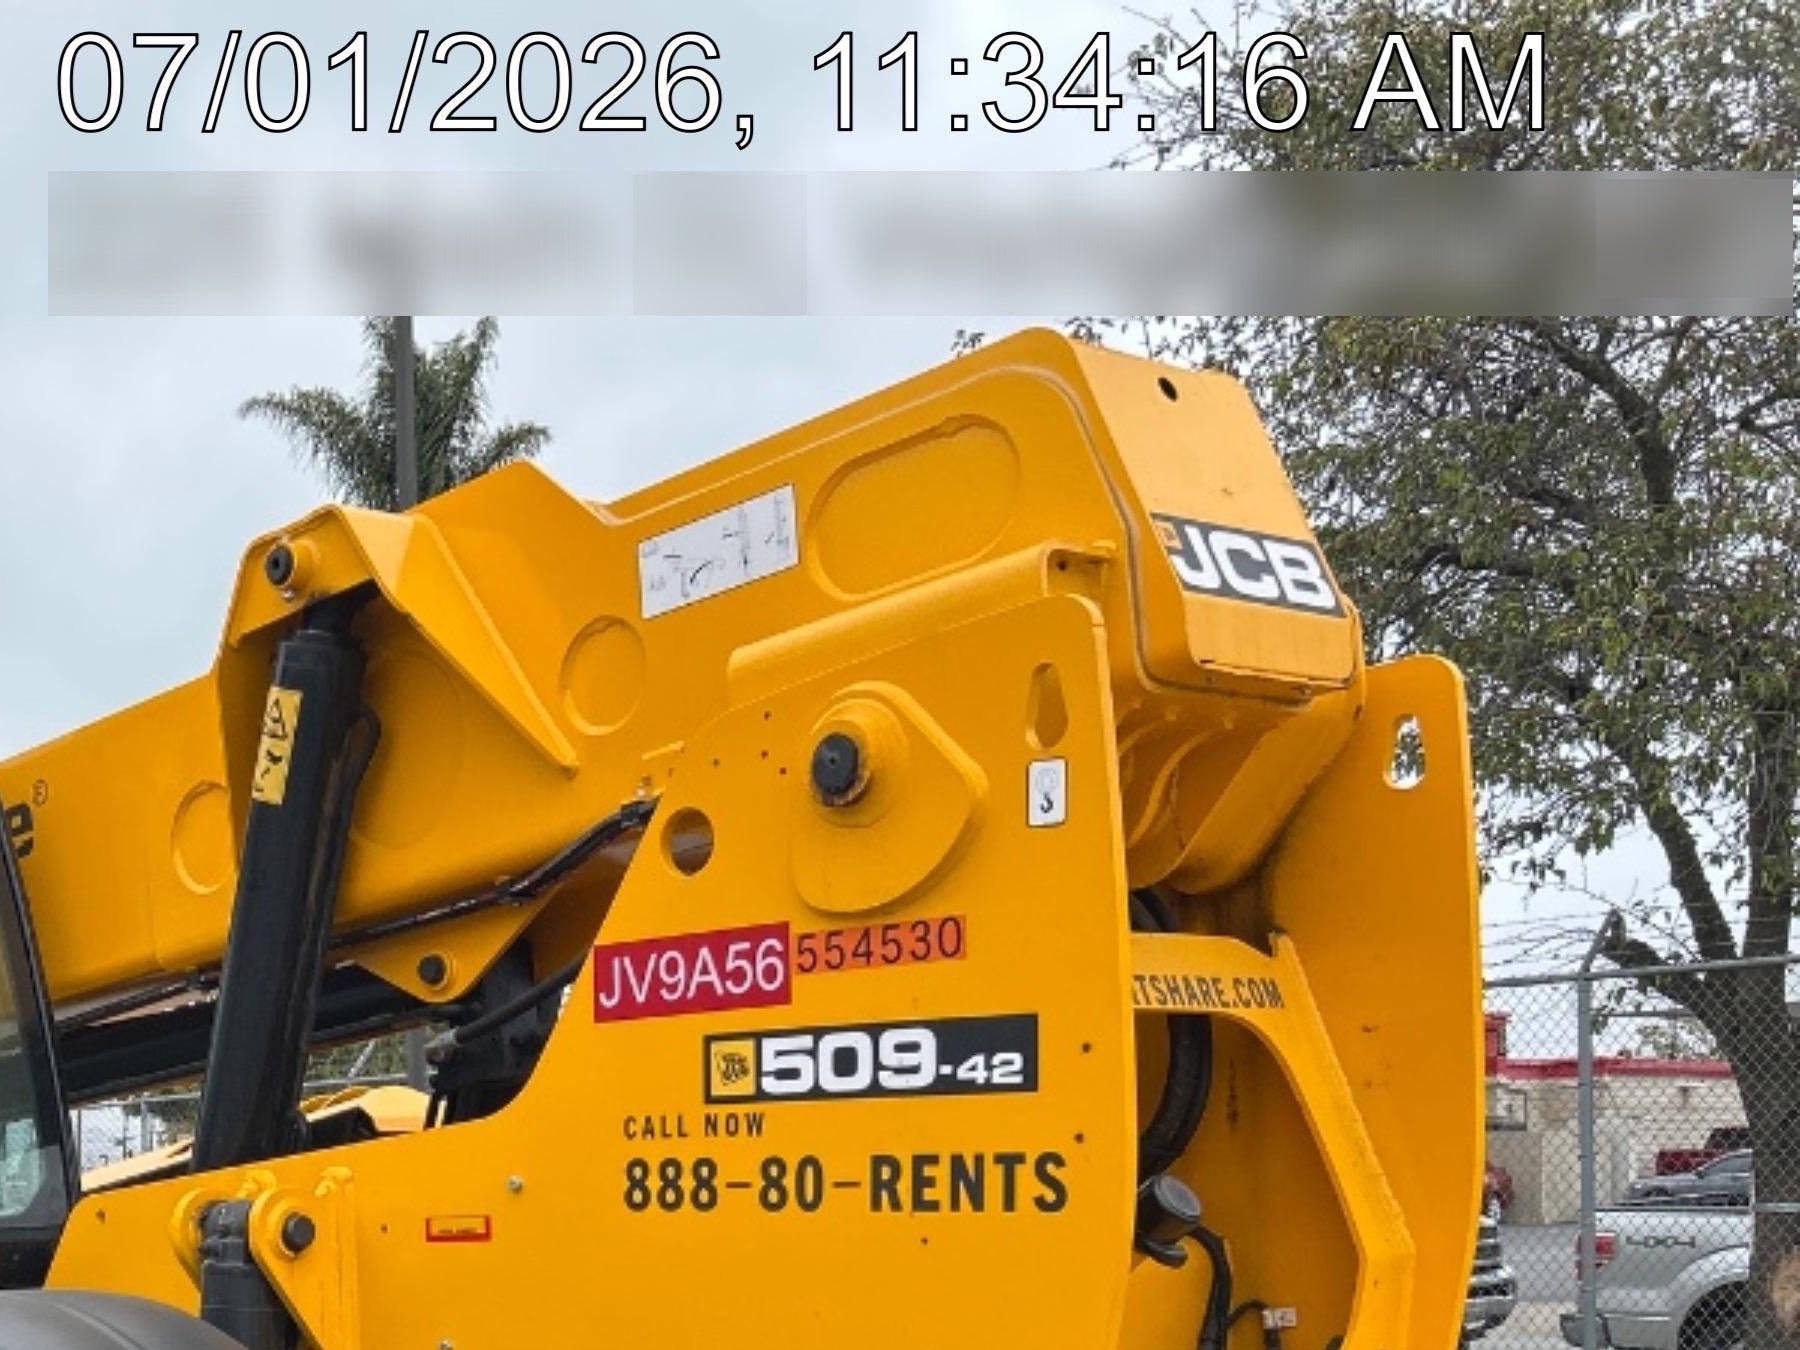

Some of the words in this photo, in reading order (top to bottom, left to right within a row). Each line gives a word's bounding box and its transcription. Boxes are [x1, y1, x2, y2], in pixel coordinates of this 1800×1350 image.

[1170, 524, 1337, 609] JCB
[599, 938, 784, 1008] JV9A56
[797, 917, 962, 973] 554530
[760, 1028, 1024, 1094] 509-42
[624, 1115, 689, 1140] CALL
[704, 1112, 765, 1138] NOW
[624, 1151, 1069, 1214] 888-80-RENTS
